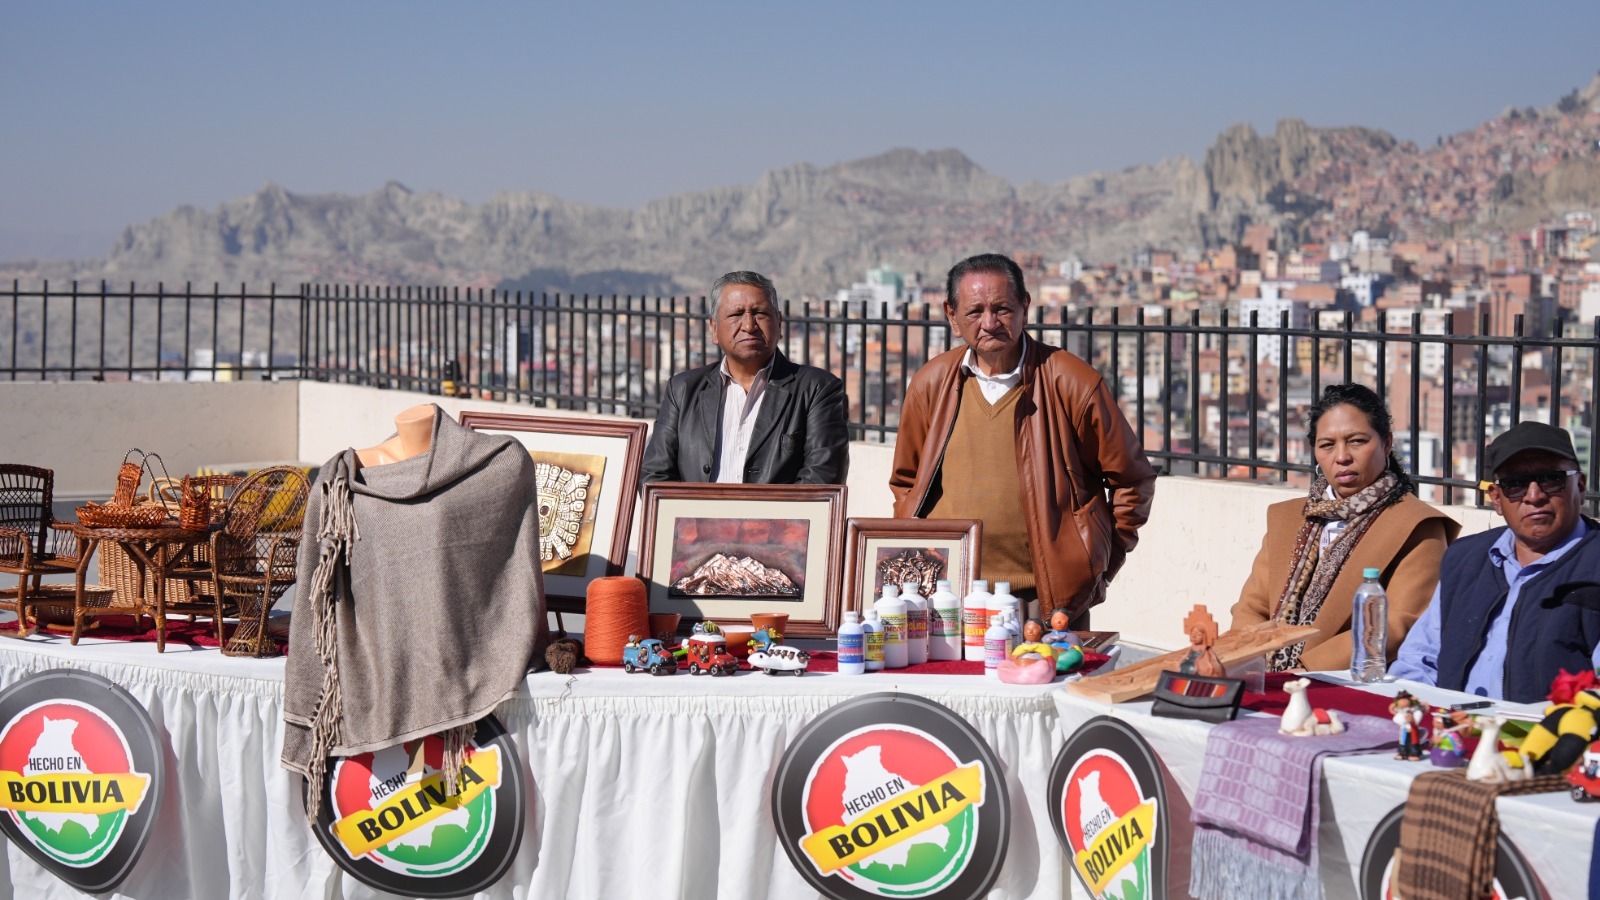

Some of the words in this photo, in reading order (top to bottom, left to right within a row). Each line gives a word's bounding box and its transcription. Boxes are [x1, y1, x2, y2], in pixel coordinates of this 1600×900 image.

[29, 757, 64, 771] HECHO
[67, 756, 82, 770] EN
[7, 780, 125, 804] BOLIVIA
[844, 786, 886, 816] HECHO
[885, 777, 905, 796] EN
[828, 781, 967, 859] BOLIVIA
[1083, 814, 1102, 841] HECHO
[1101, 807, 1112, 824] EN
[1084, 817, 1144, 885] BOLIVIA
